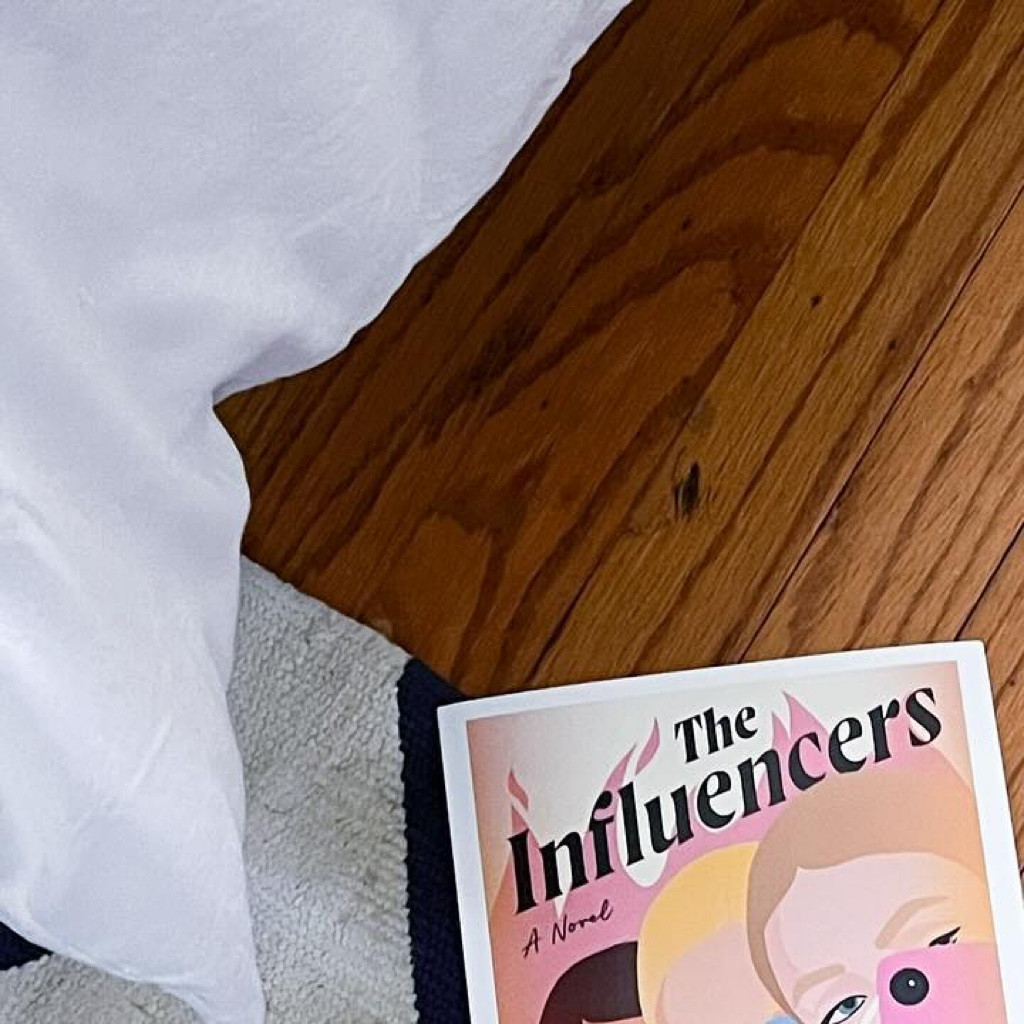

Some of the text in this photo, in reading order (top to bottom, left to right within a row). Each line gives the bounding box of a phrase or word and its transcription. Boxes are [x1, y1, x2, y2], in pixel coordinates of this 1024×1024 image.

[674, 706, 757, 762] The
[507, 687, 941, 914] Influencers
[522, 899, 613, 958] A Novel
